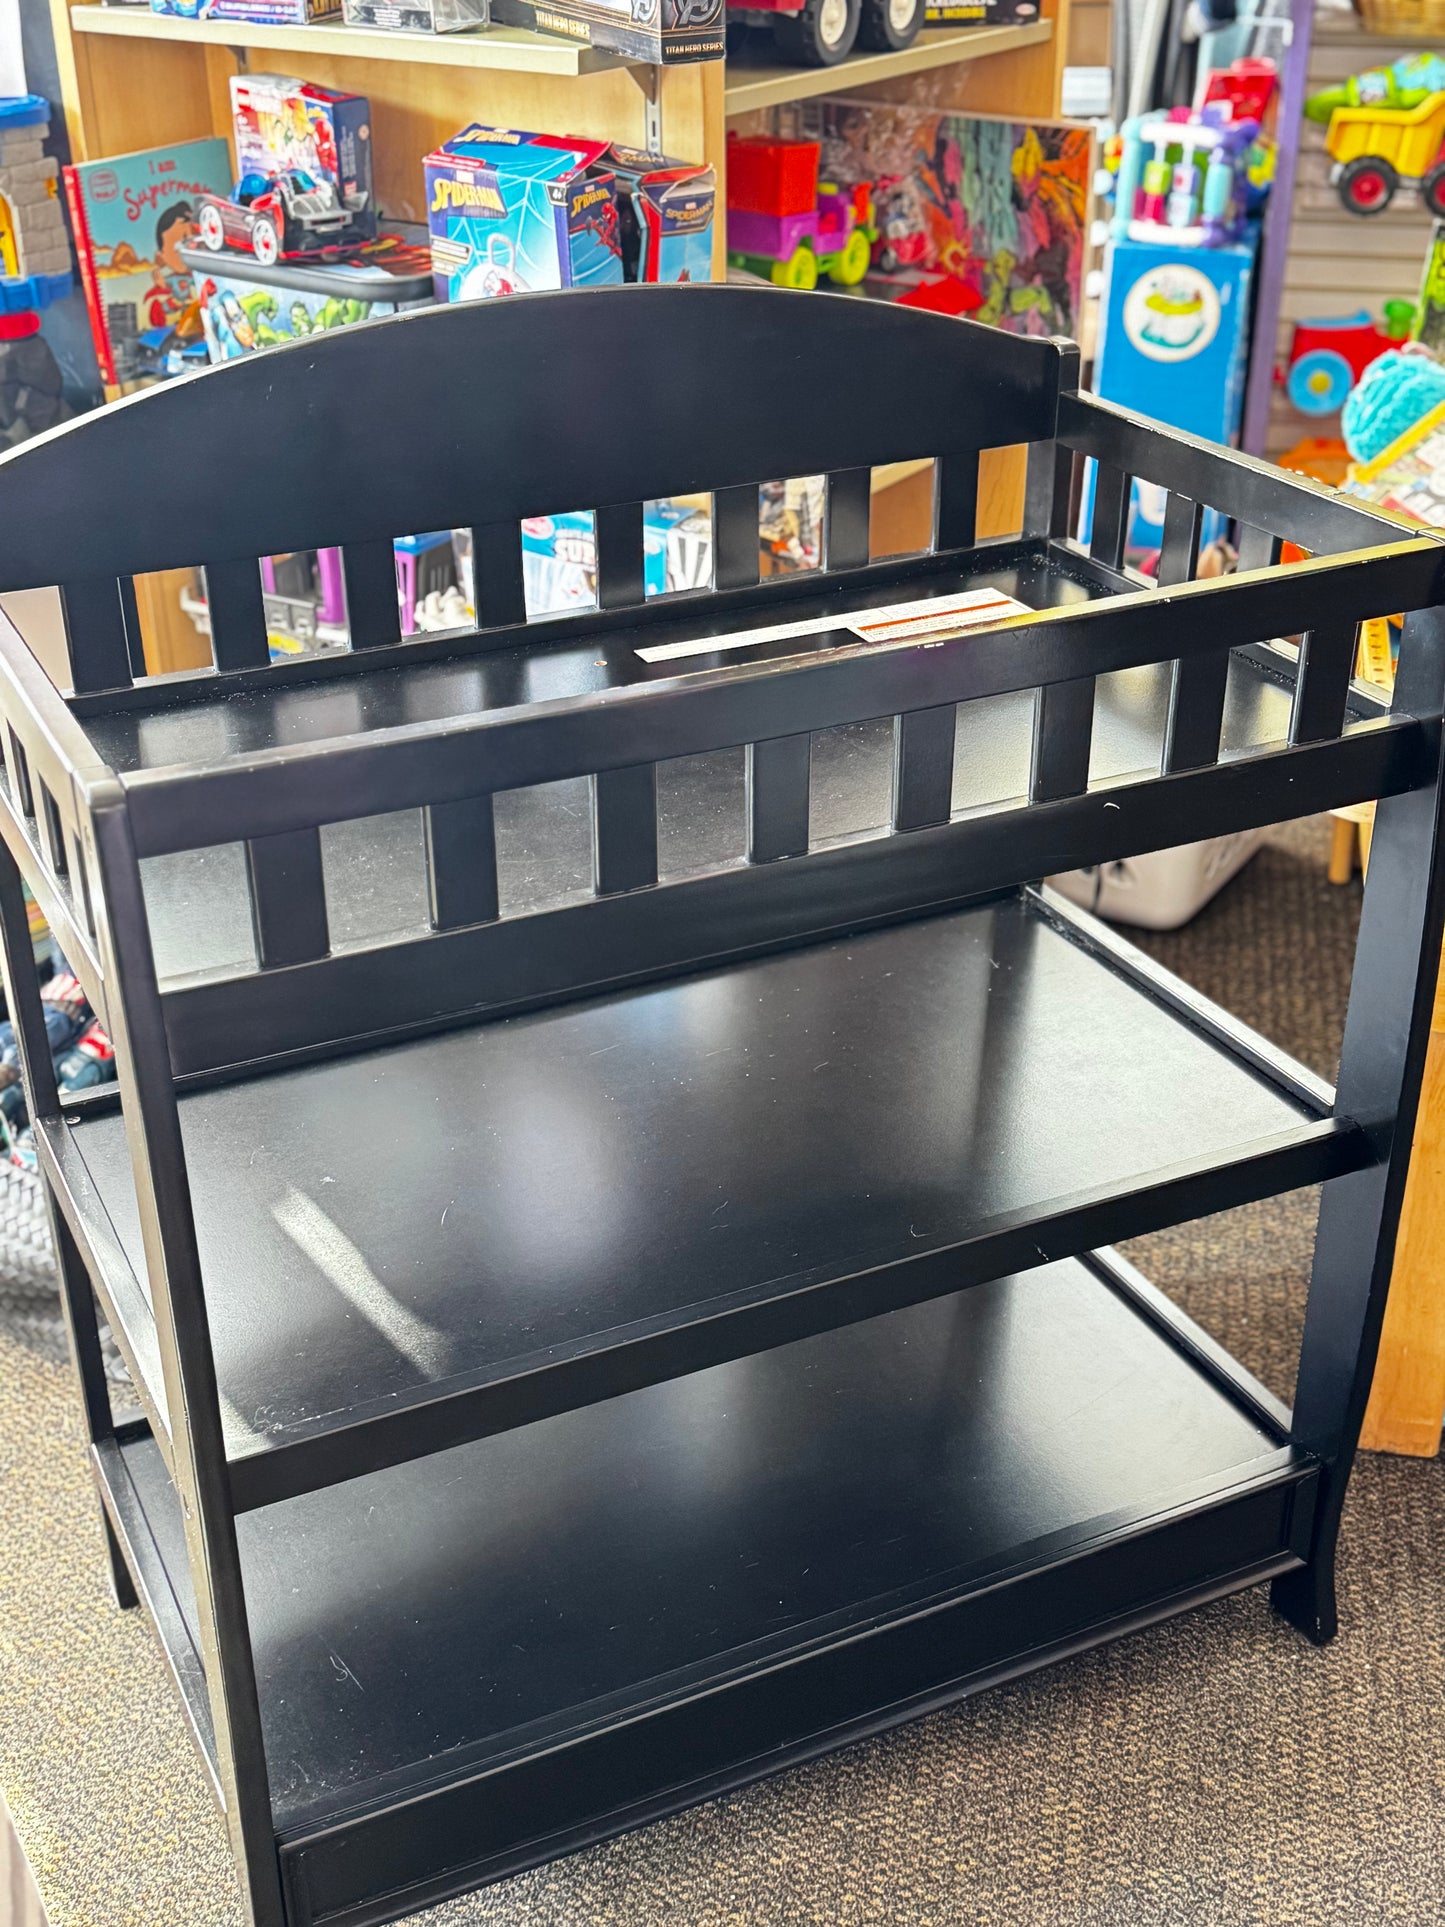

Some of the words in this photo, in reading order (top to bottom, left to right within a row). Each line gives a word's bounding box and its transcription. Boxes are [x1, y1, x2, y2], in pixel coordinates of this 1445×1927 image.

[535, 9, 553, 29] TITAN
[553, 14, 568, 33] HERO
[568, 19, 590, 40] SERIES
[665, 45, 684, 56] TITAN
[685, 43, 702, 54] HERO
[702, 41, 724, 53] SERIES
[431, 177, 507, 213] SPIDER-MAN
[571, 188, 611, 218] SPIDER-MAN
[665, 200, 713, 220] SPIDER-MAN
